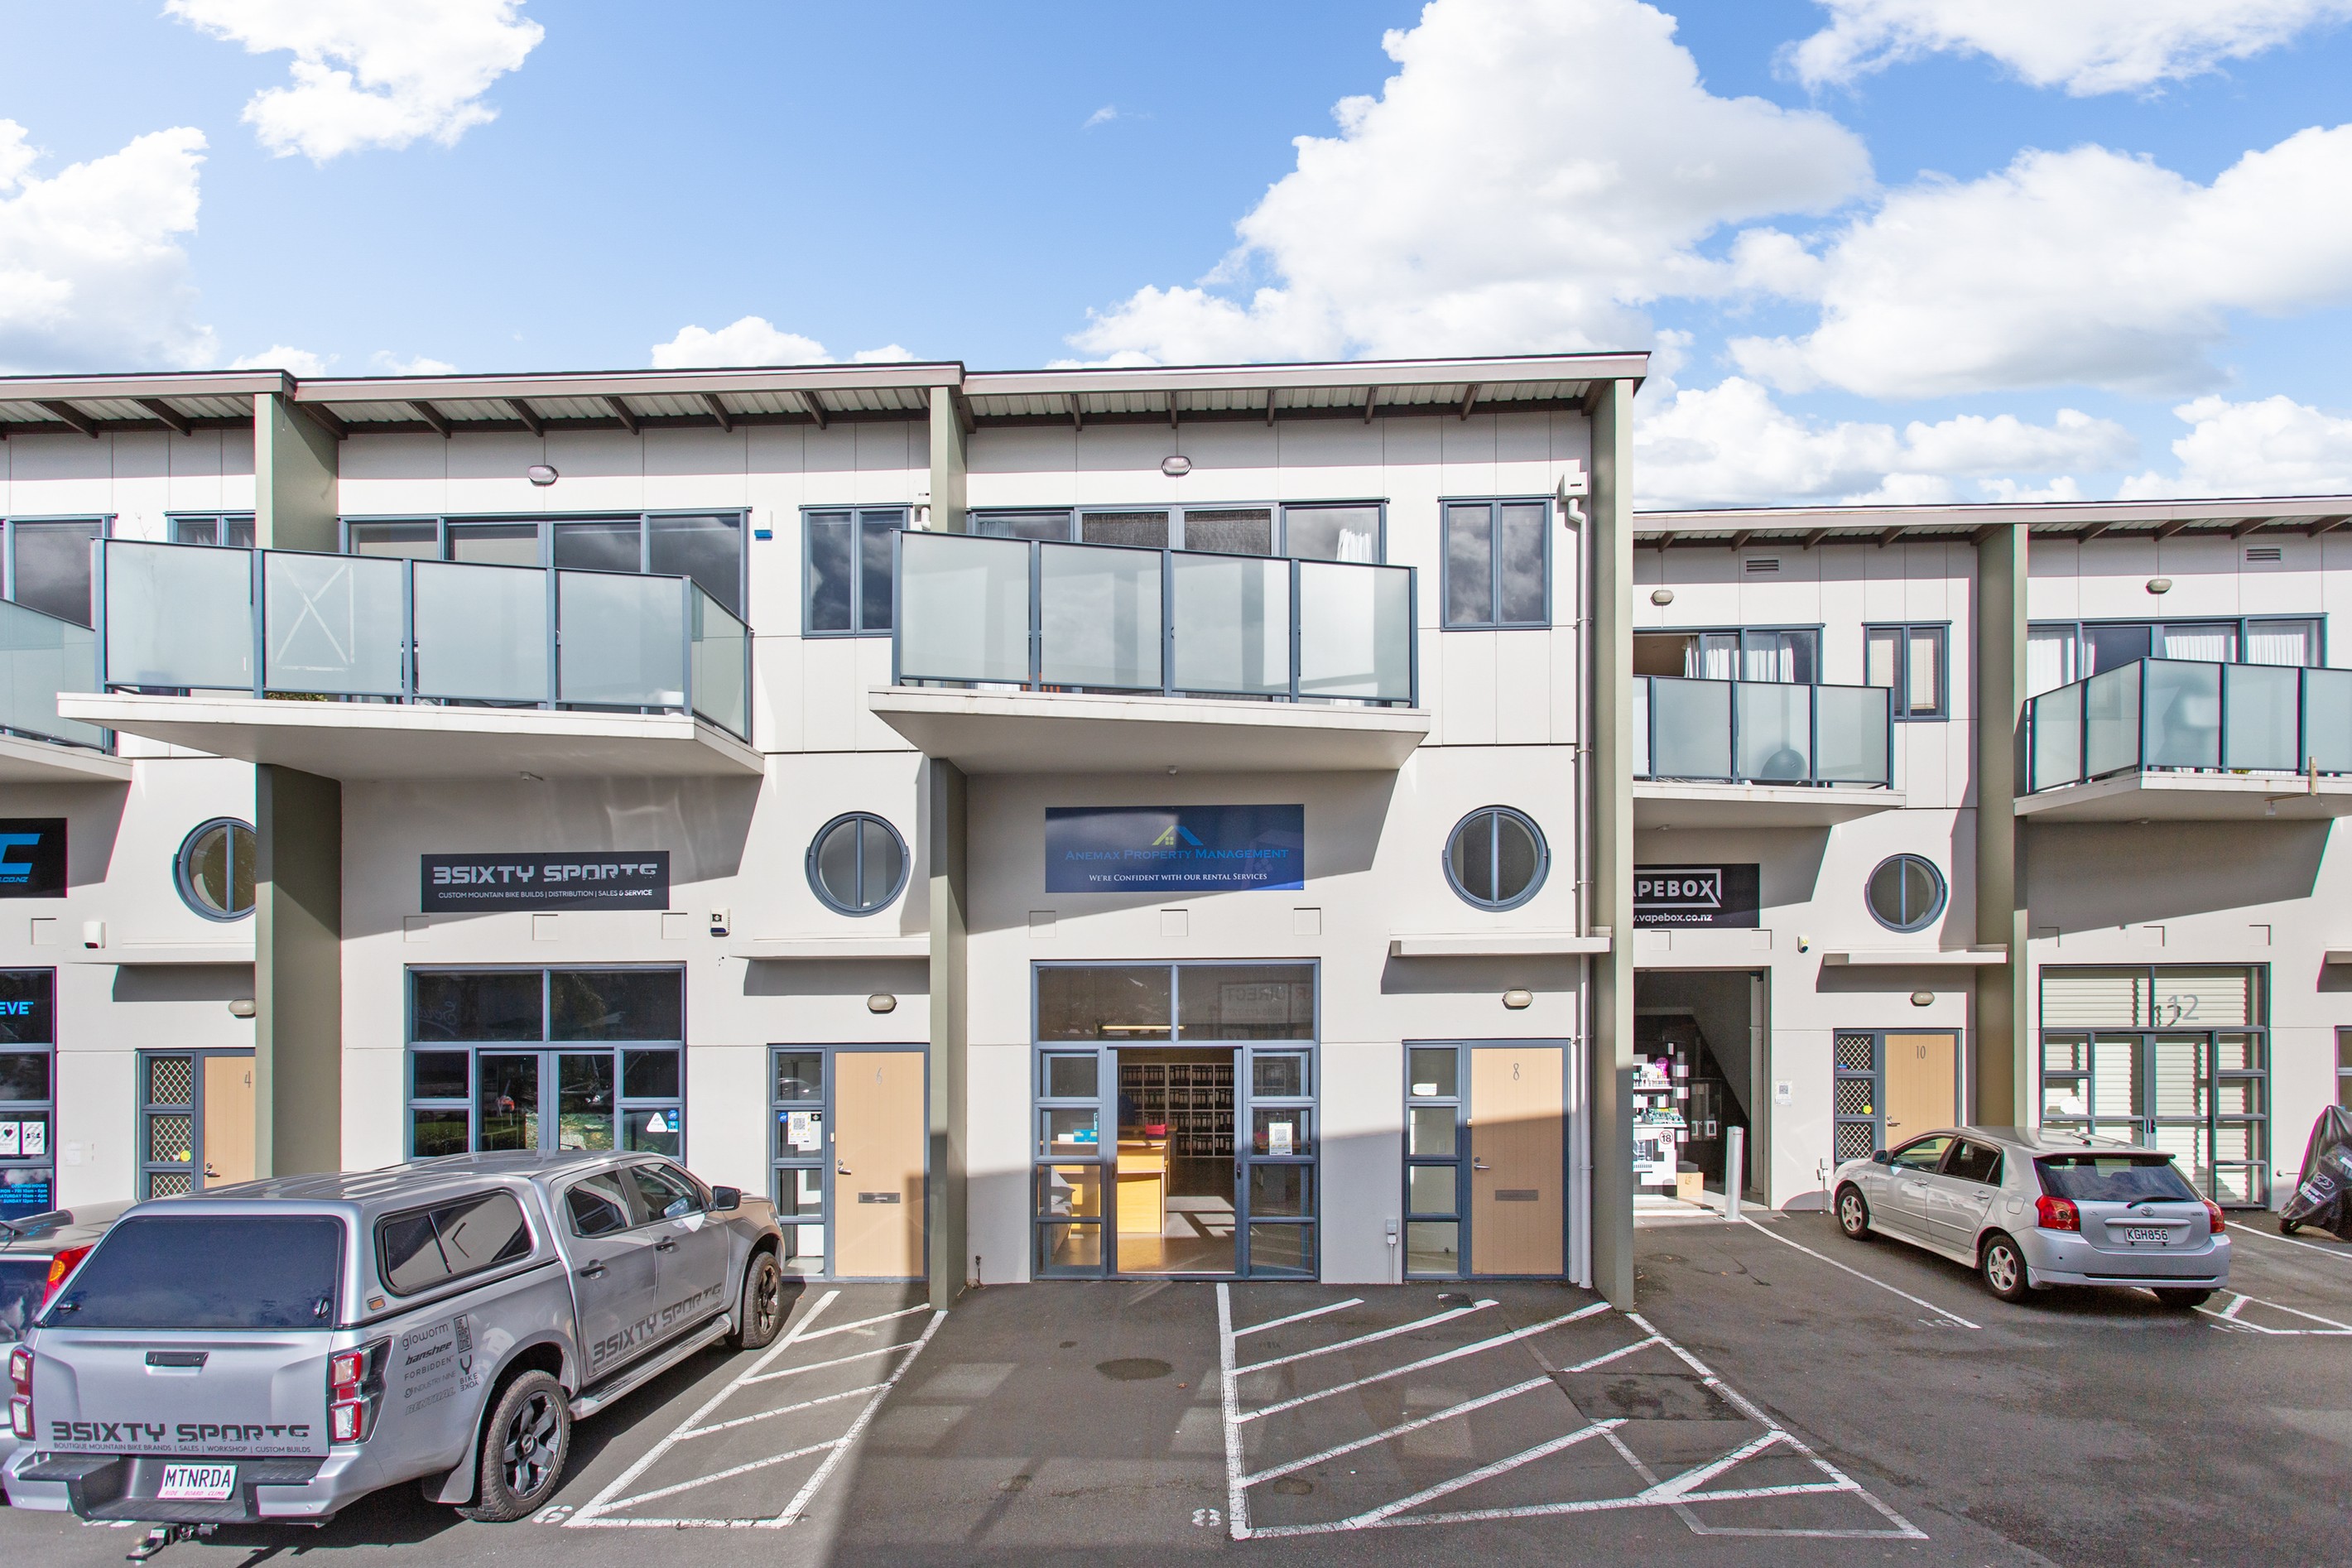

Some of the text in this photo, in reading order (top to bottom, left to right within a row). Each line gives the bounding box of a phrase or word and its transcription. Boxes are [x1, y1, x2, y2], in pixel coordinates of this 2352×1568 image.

[1065, 849, 1288, 860] ANEMAX PROPERTY MANAGEMENT
[433, 863, 657, 884] 3SIXTY SPORTS
[1113, 873, 1160, 882] CONFIDENT
[624, 888, 652, 897] SERVICE
[1633, 880, 1715, 897] PEBOX
[2167, 993, 2200, 1021] 12
[1916, 1045, 1926, 1060] 10
[244, 1070, 253, 1089] 4
[876, 1066, 883, 1085] 6
[1513, 1062, 1520, 1081] 8
[1662, 1134, 1671, 1143] 18
[2127, 1229, 2168, 1240] KGH856
[402, 1323, 449, 1351] gloworm
[592, 1314, 657, 1367] 3SIXTY
[404, 1340, 453, 1366] banshee
[403, 1355, 452, 1381] FORBIDDEN
[460, 1372, 479, 1385] BIKE
[51, 1421, 310, 1442] 3SIXTY SPORTS
[164, 1469, 230, 1488] MTNRDA
[532, 1504, 573, 1524] 6
[1191, 1508, 1221, 1527] 8
